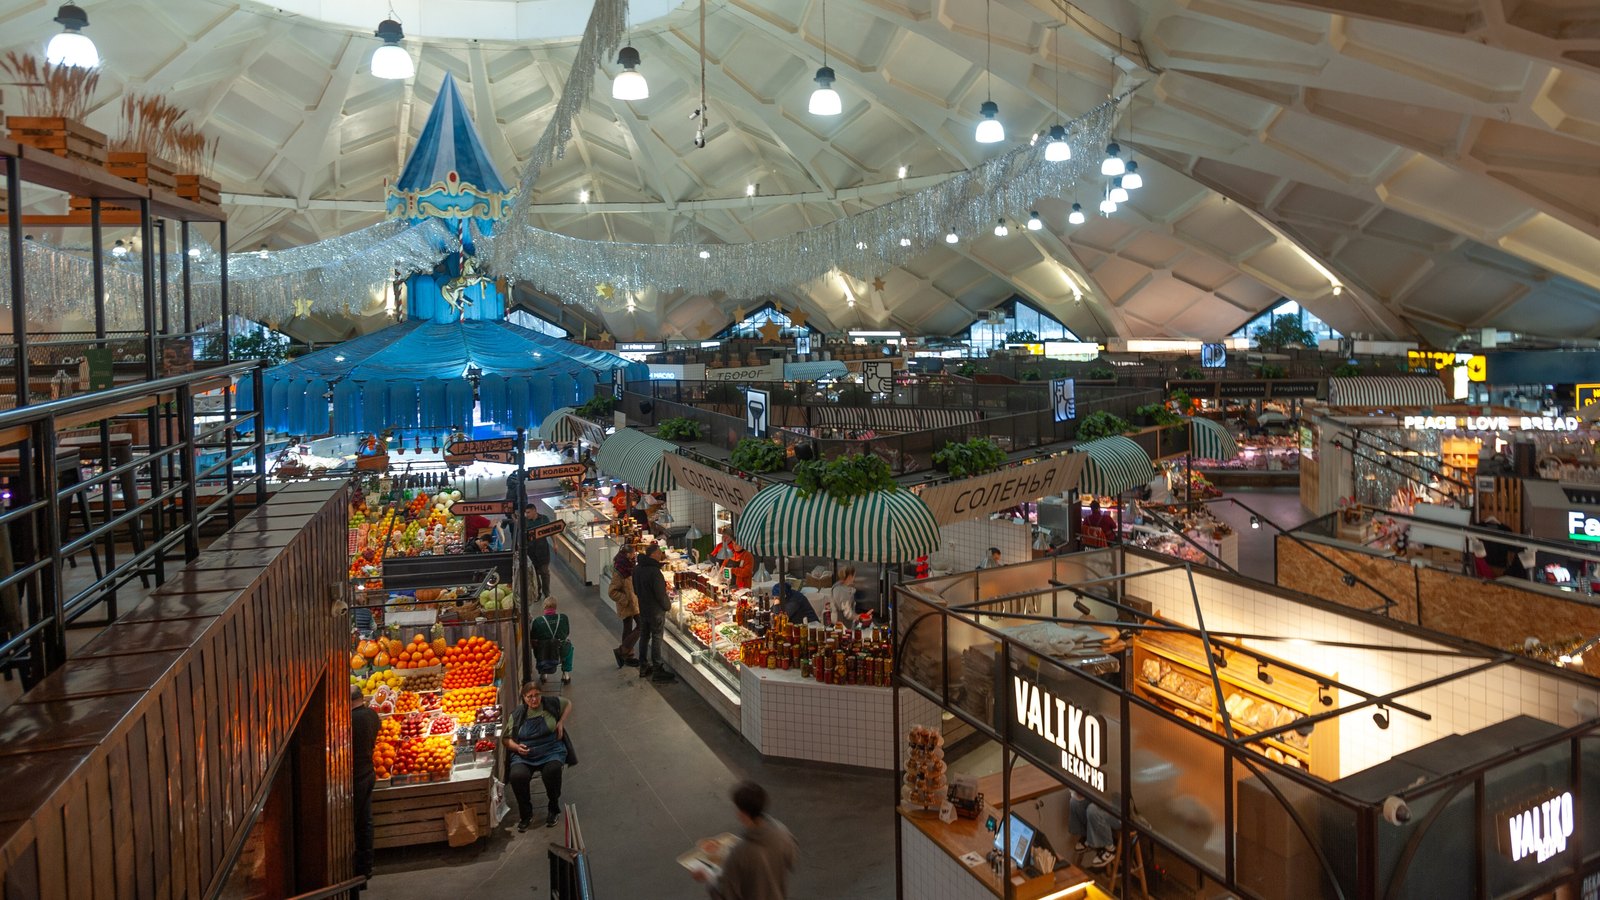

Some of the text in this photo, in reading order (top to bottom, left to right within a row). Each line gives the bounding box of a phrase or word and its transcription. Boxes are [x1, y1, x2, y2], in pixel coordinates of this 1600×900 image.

[717, 369, 764, 381] ТВОРОГ
[1404, 416, 1579, 431] PEACE LOVE BREAD
[542, 466, 580, 476] КОЛБАСЫ
[682, 466, 747, 508] СОЛЕНЬЯ
[953, 468, 1057, 514] СОЛЕНЬЯ
[462, 505, 493, 513] ПТИЦА
[1014, 675, 1101, 768] VALIKO
[1061, 749, 1104, 793] ПЕКАРНЯ
[1509, 791, 1574, 862] VALIKO
